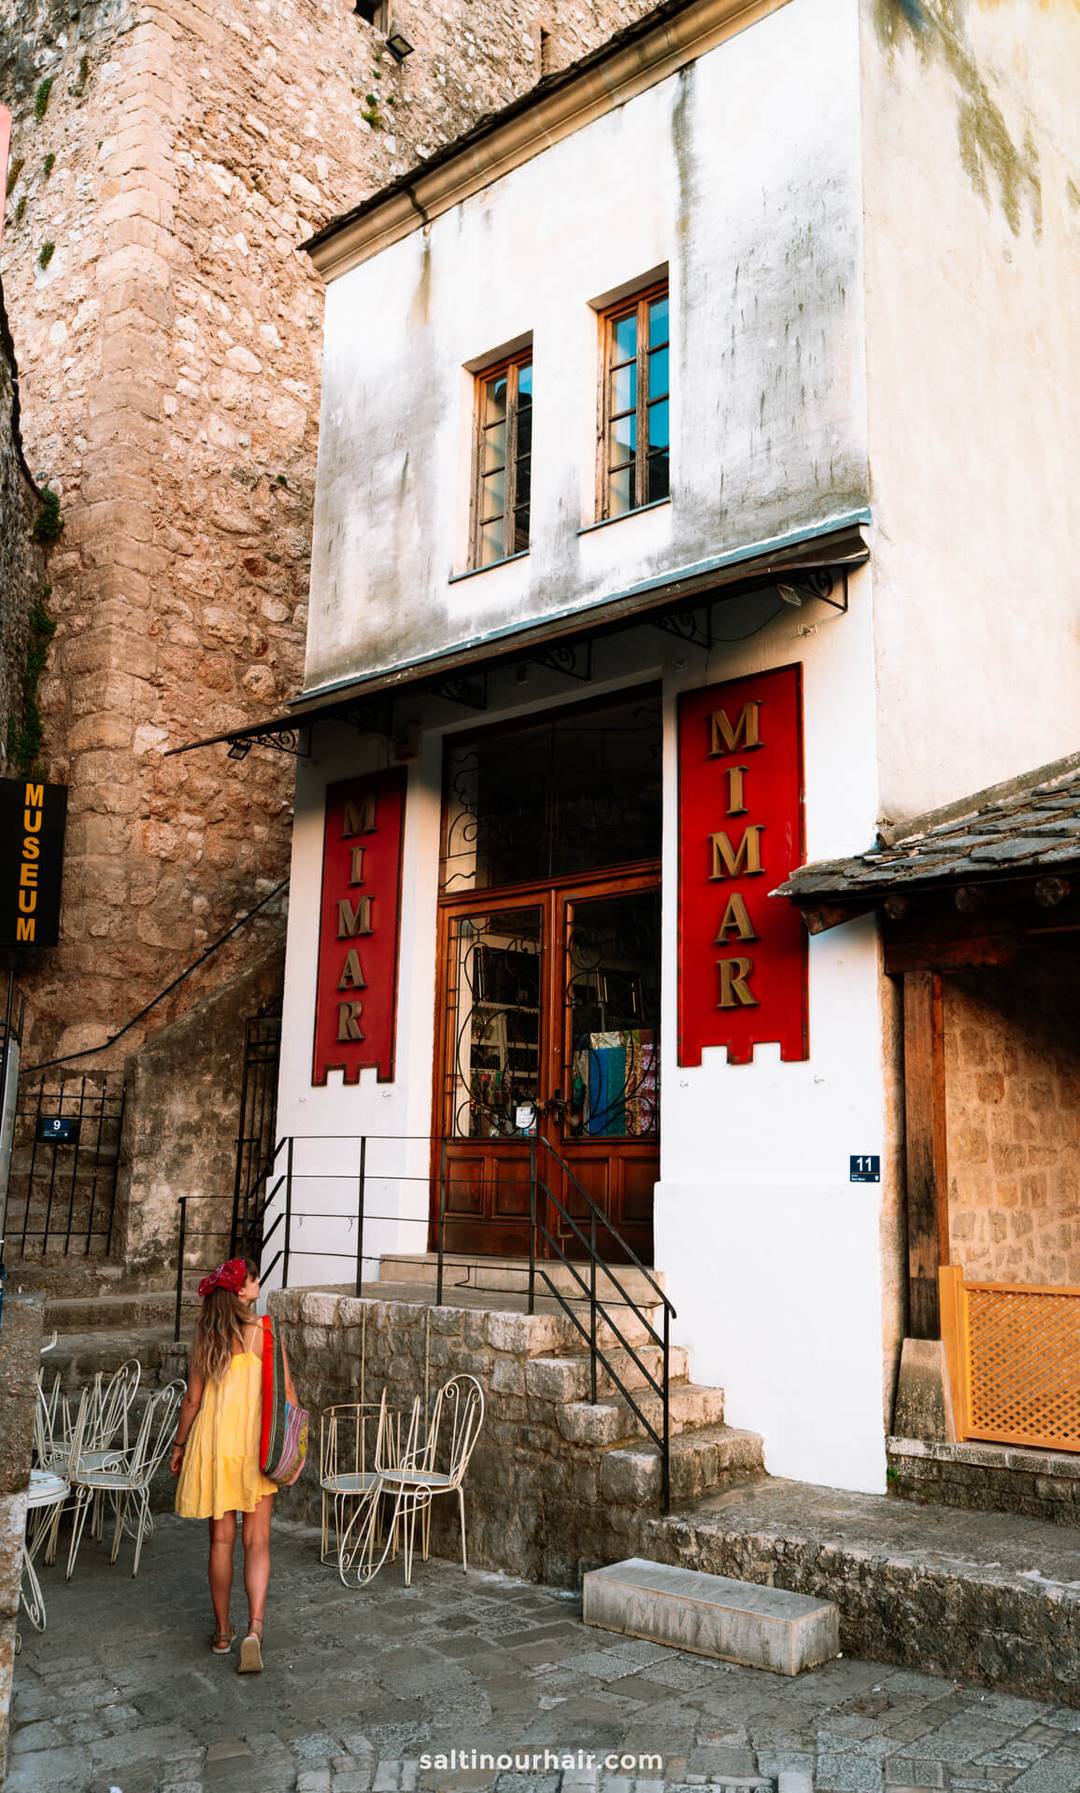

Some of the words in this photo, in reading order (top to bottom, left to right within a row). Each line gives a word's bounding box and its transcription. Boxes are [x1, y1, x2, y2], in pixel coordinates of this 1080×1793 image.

[16, 783, 45, 942] MUSEUM
[336, 795, 377, 1042] MIMAR
[709, 699, 765, 1008] MIMAR
[53, 1119, 61, 1130] 9
[856, 1157, 872, 1172] 11
